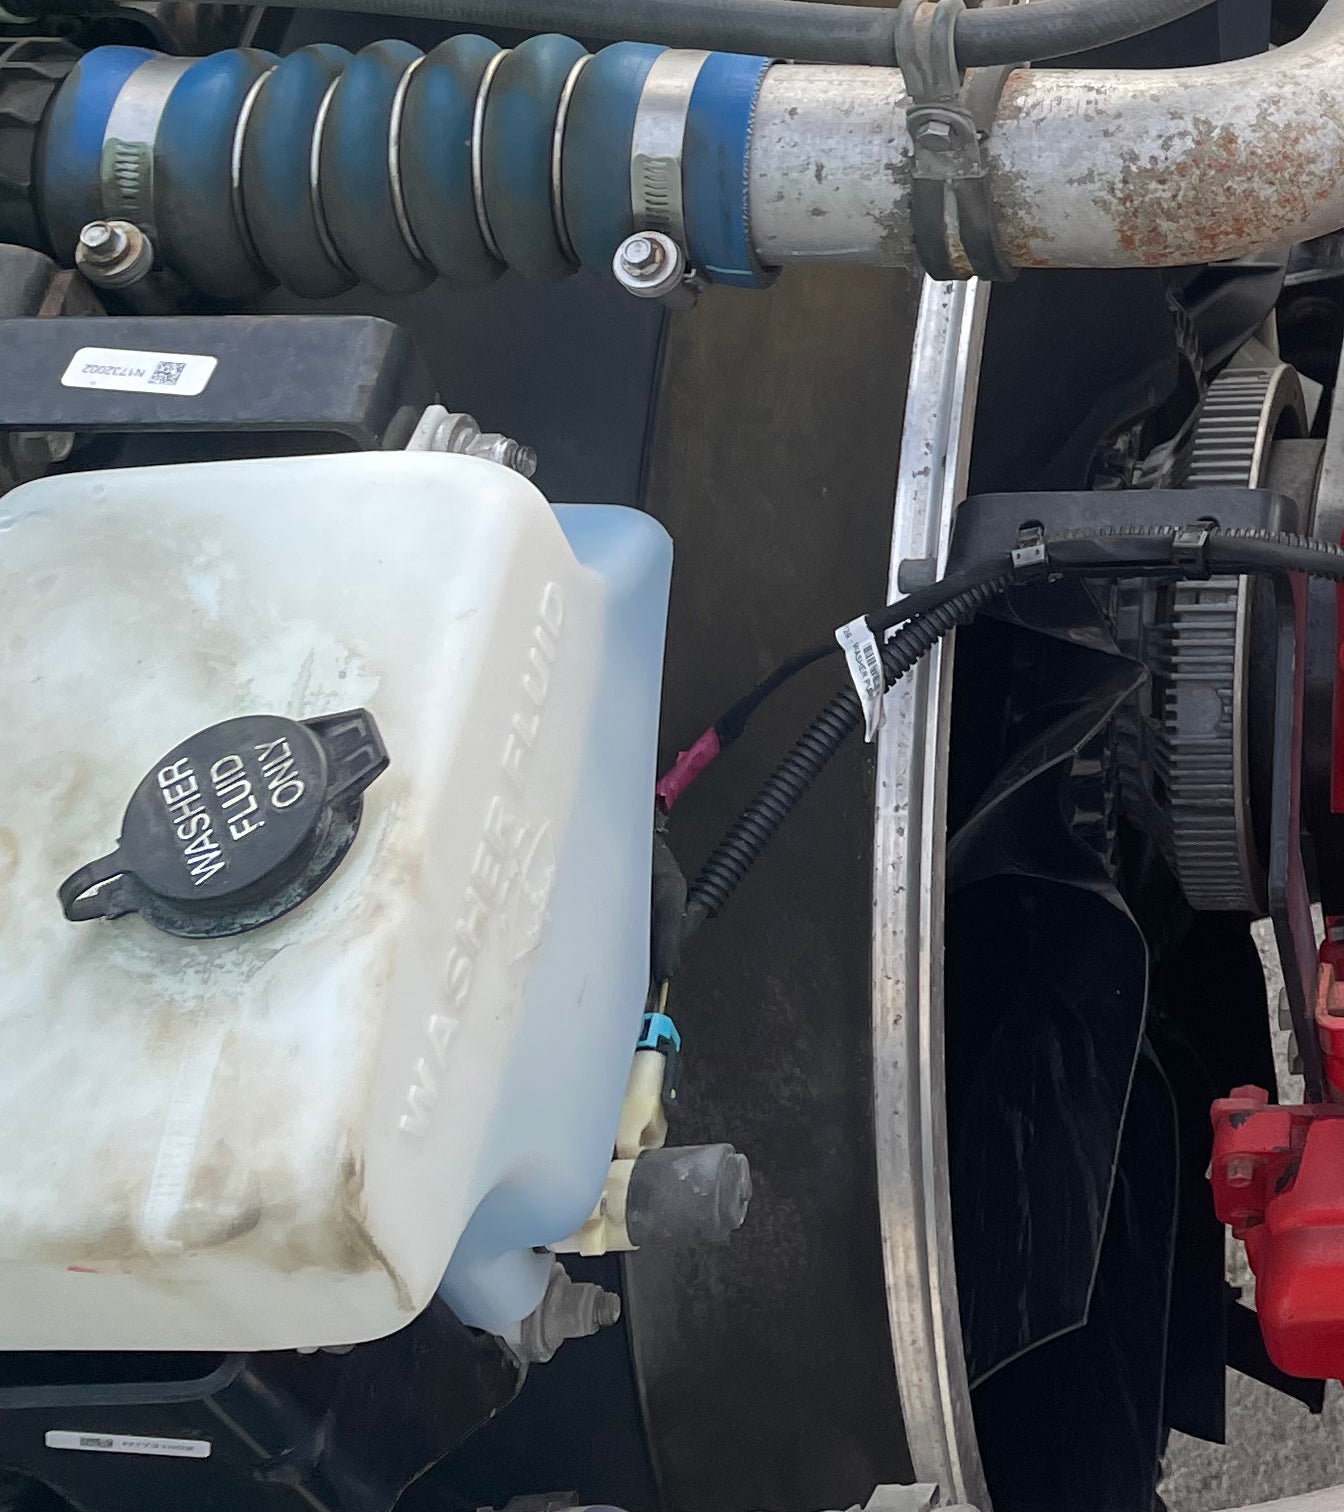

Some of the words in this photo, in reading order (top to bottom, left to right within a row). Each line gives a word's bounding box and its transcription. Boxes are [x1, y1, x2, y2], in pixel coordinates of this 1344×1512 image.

[158, 757, 226, 886] WASHER
[210, 754, 266, 841] FLUID
[254, 736, 305, 809] ONLY
[400, 794, 516, 1138] WASHER
[500, 580, 564, 786] FLUID
